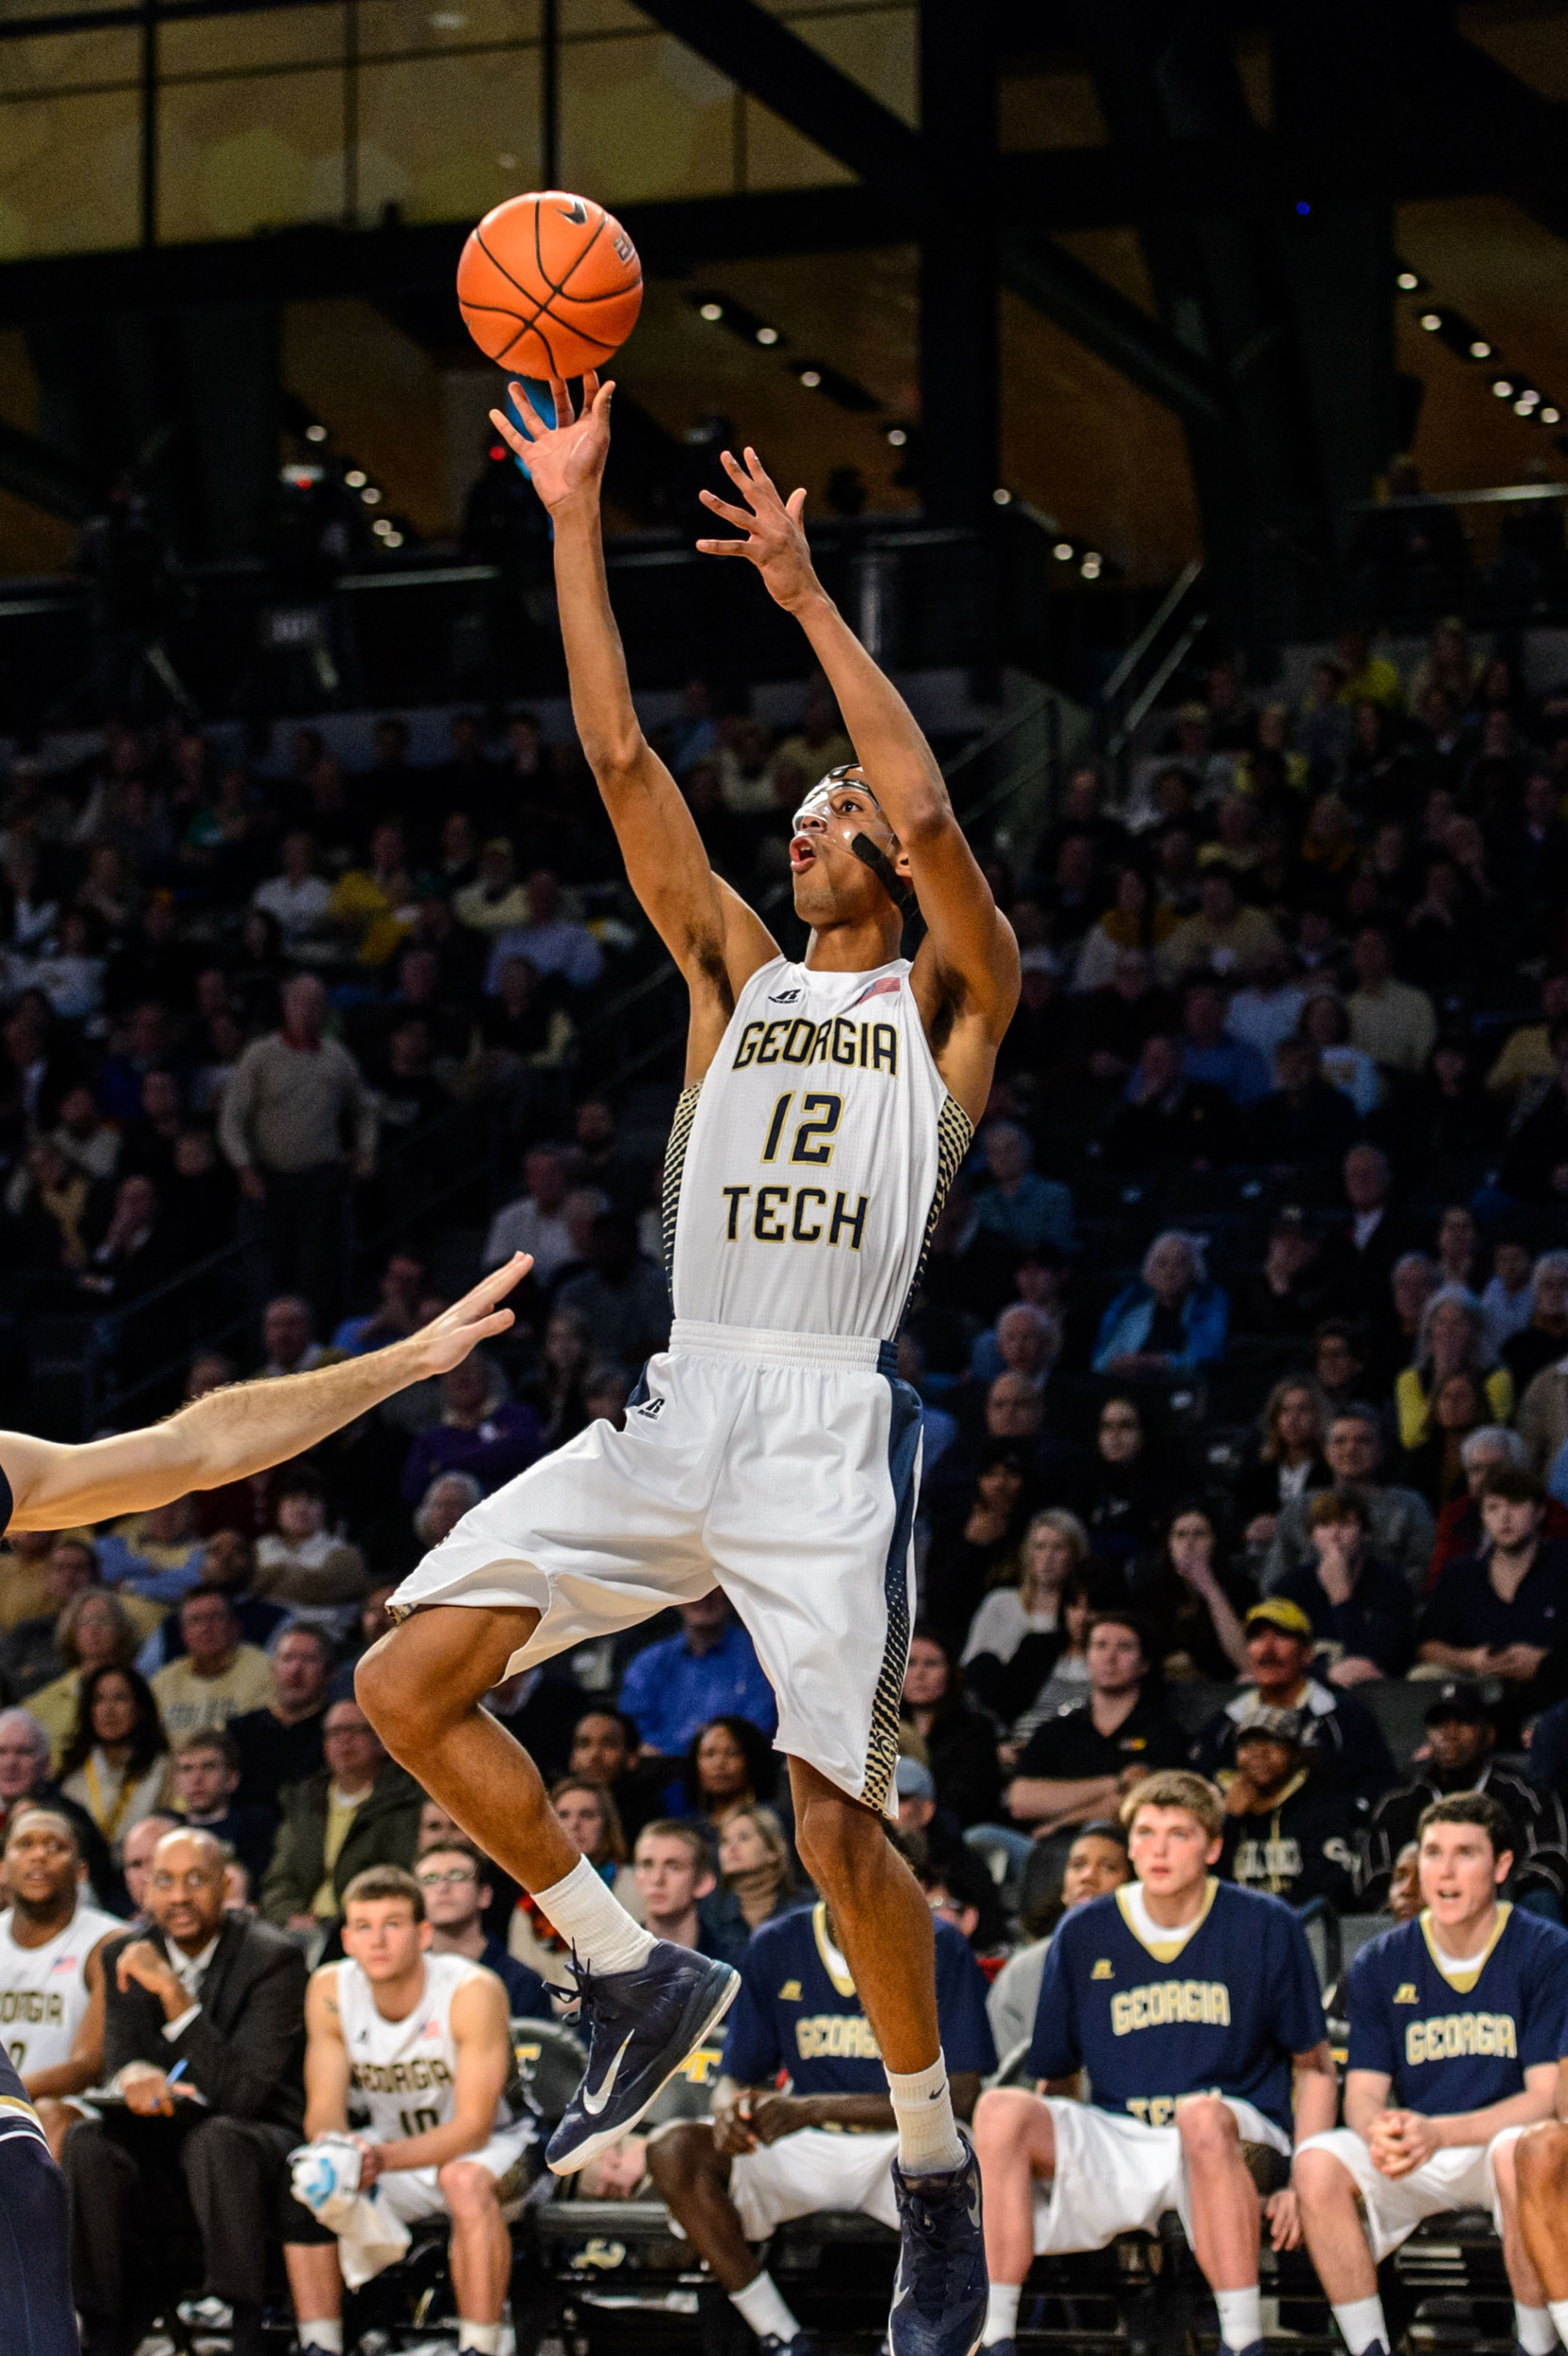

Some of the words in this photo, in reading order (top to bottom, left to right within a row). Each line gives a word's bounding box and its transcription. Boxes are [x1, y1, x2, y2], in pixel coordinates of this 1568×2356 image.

[732, 1017, 898, 1076] GEORGIA
[760, 1090, 845, 1166] 12
[722, 1184, 870, 1252] TECH
[795, 2014, 882, 2060] GEORG
[1111, 1980, 1231, 2037] GEORGIA
[1405, 2012, 1518, 2066] GEORGIA
[1126, 2086, 1222, 2128] TE
